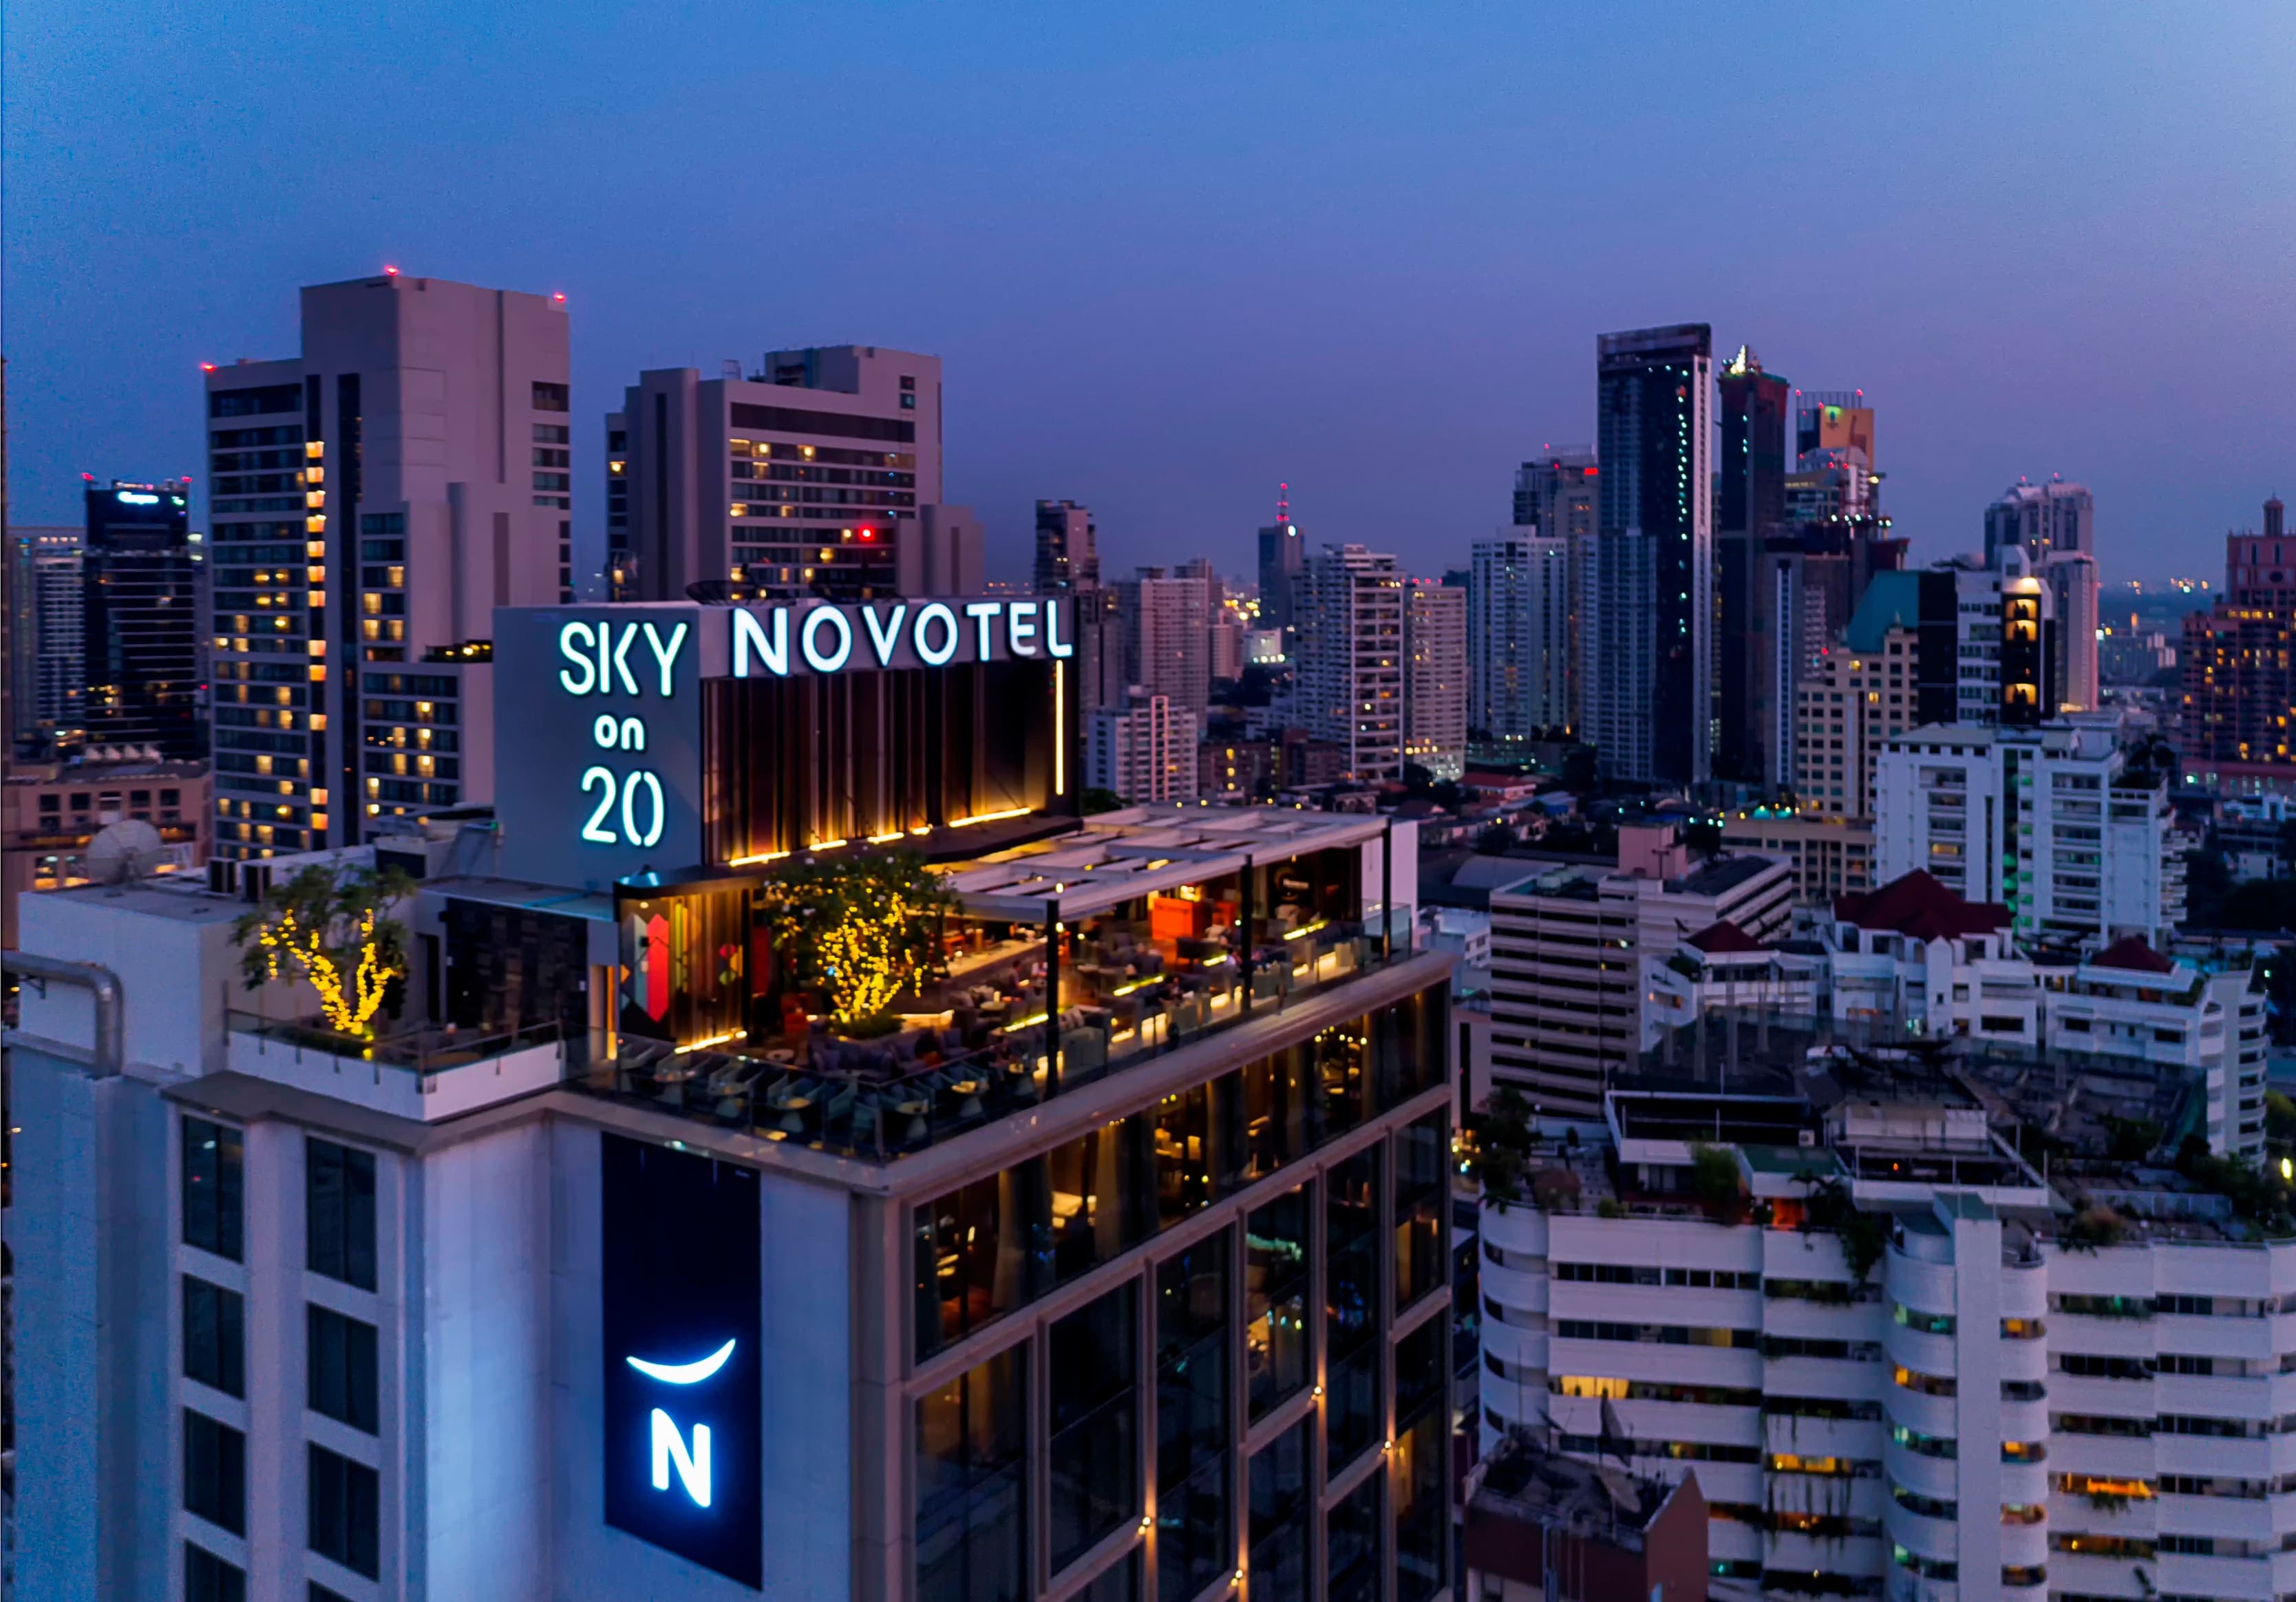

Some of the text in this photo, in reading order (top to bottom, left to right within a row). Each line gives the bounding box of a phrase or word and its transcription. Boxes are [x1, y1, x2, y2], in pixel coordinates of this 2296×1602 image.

[560, 621, 688, 696] SKY
[734, 600, 1073, 678] NOVOTEL
[594, 714, 645, 751] on
[581, 766, 664, 847] 20
[651, 1407, 712, 1508] N
